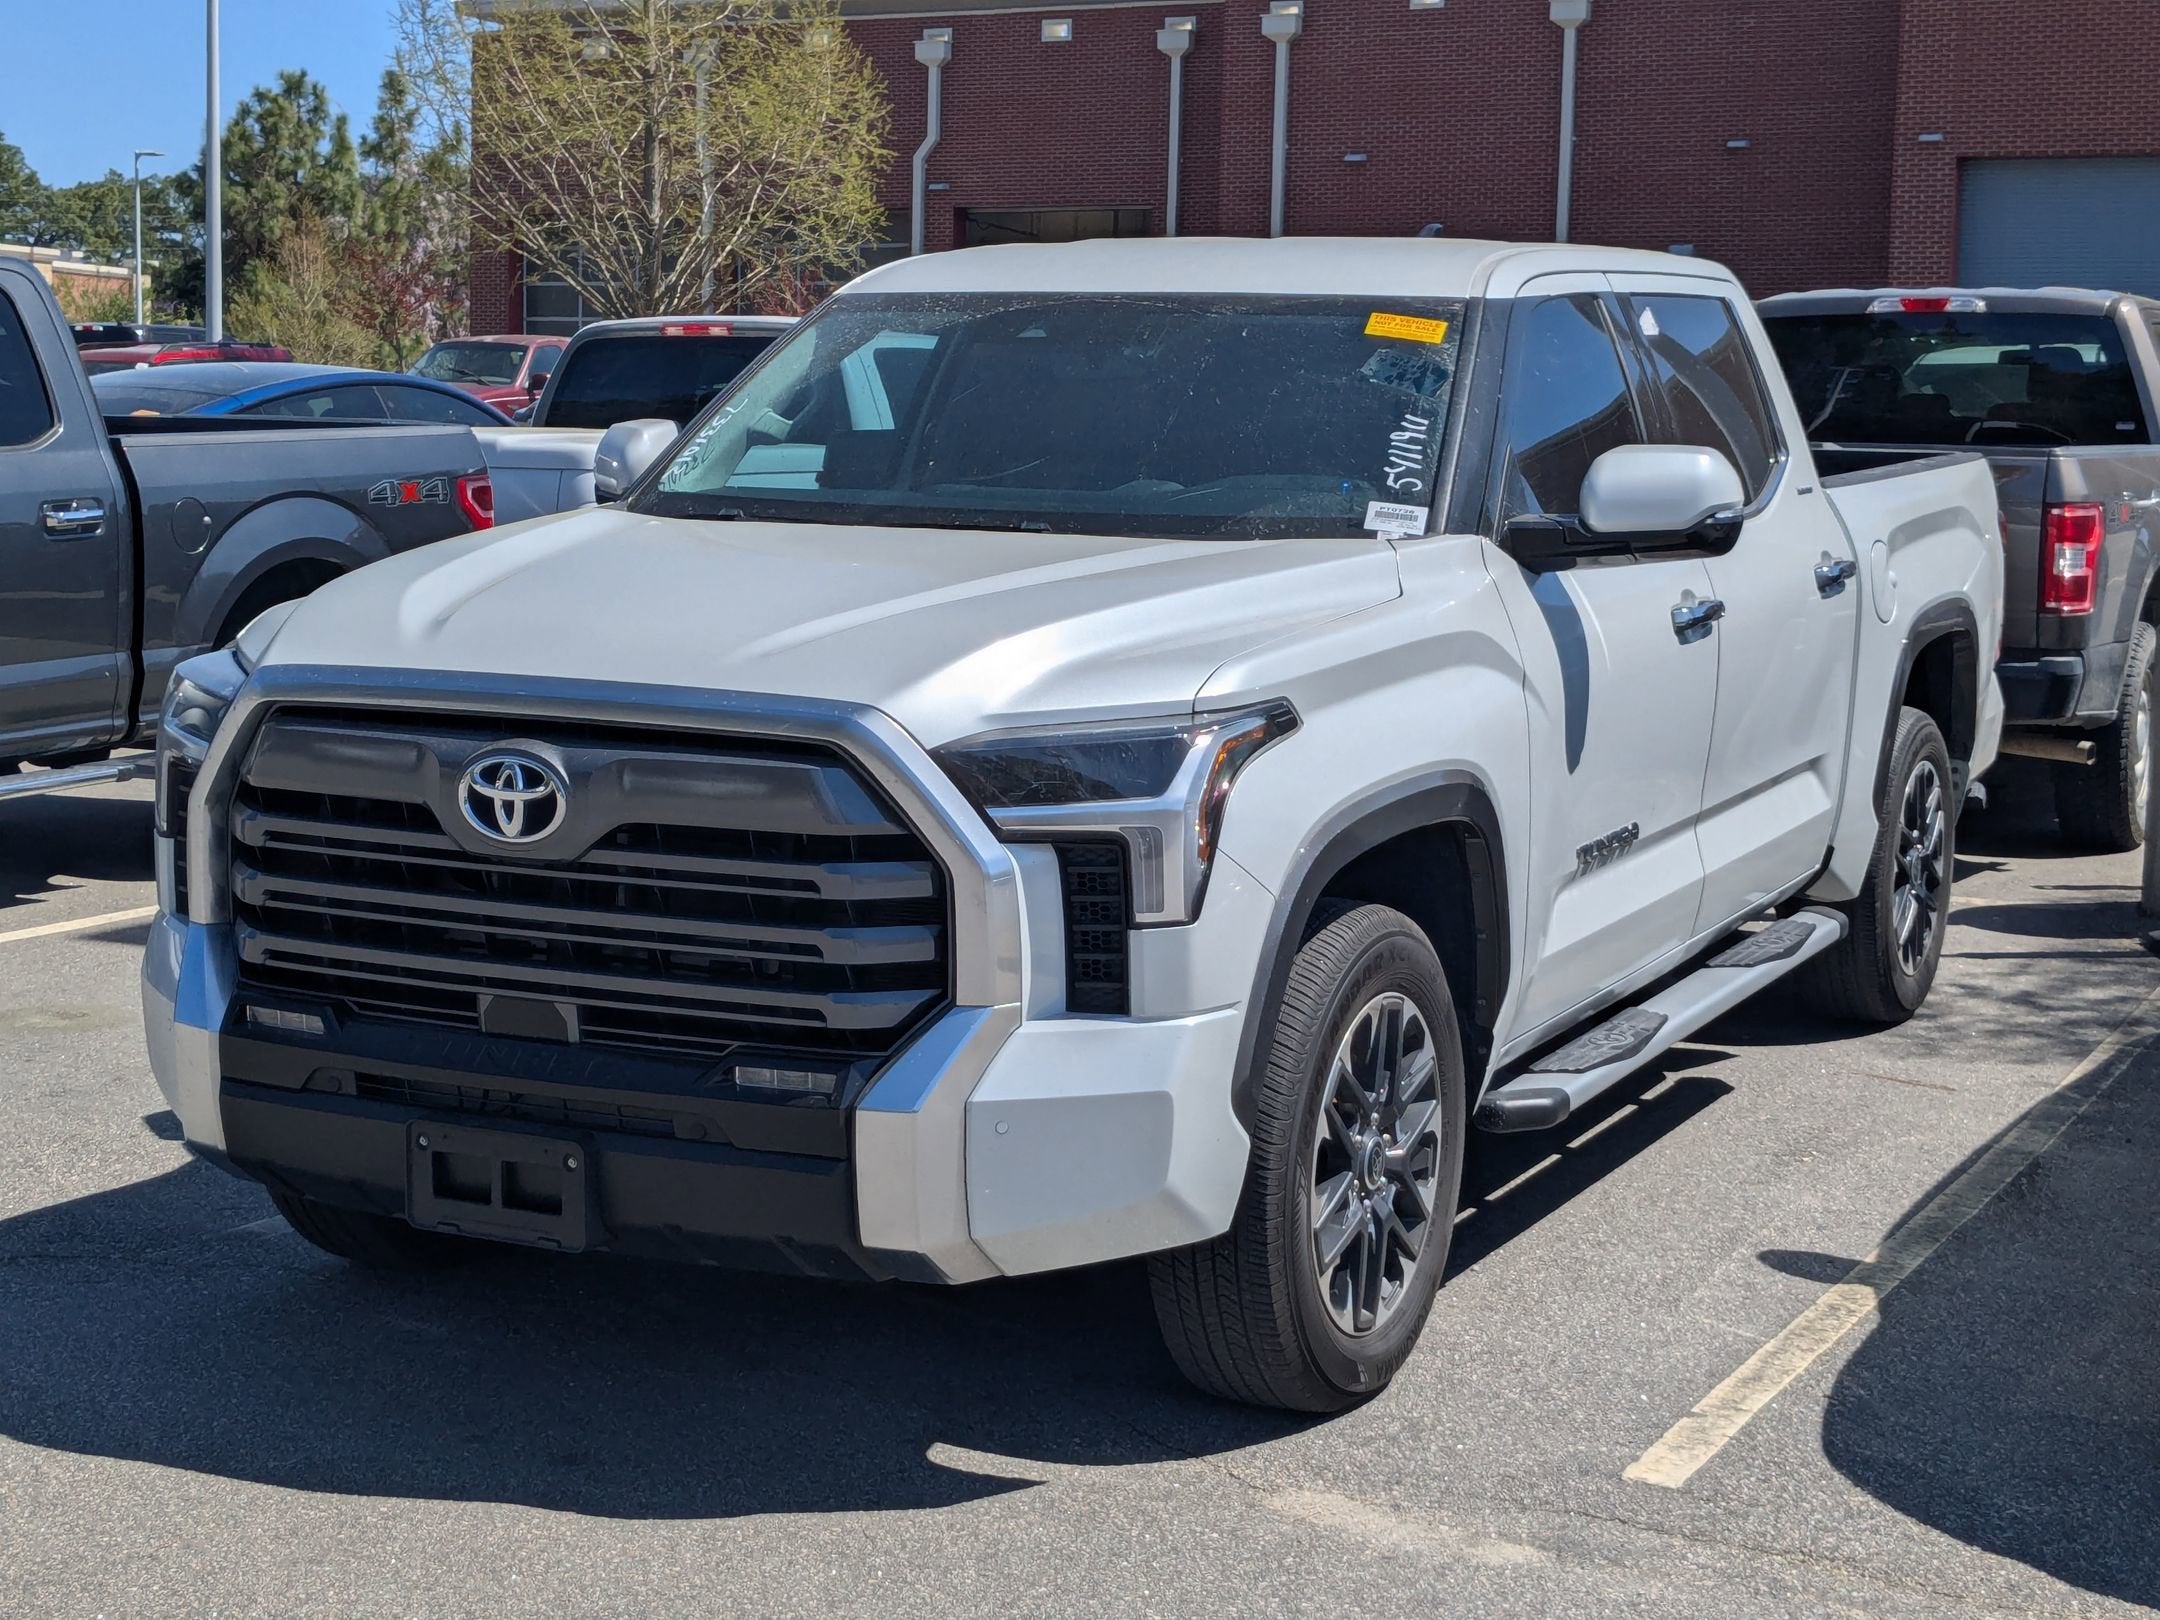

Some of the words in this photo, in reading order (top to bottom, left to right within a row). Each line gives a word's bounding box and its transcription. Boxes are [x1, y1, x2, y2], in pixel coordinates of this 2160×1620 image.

[1375, 314, 1396, 322] THIS
[1399, 317, 1440, 328] VEHICLE
[1415, 325, 1437, 333] SALE
